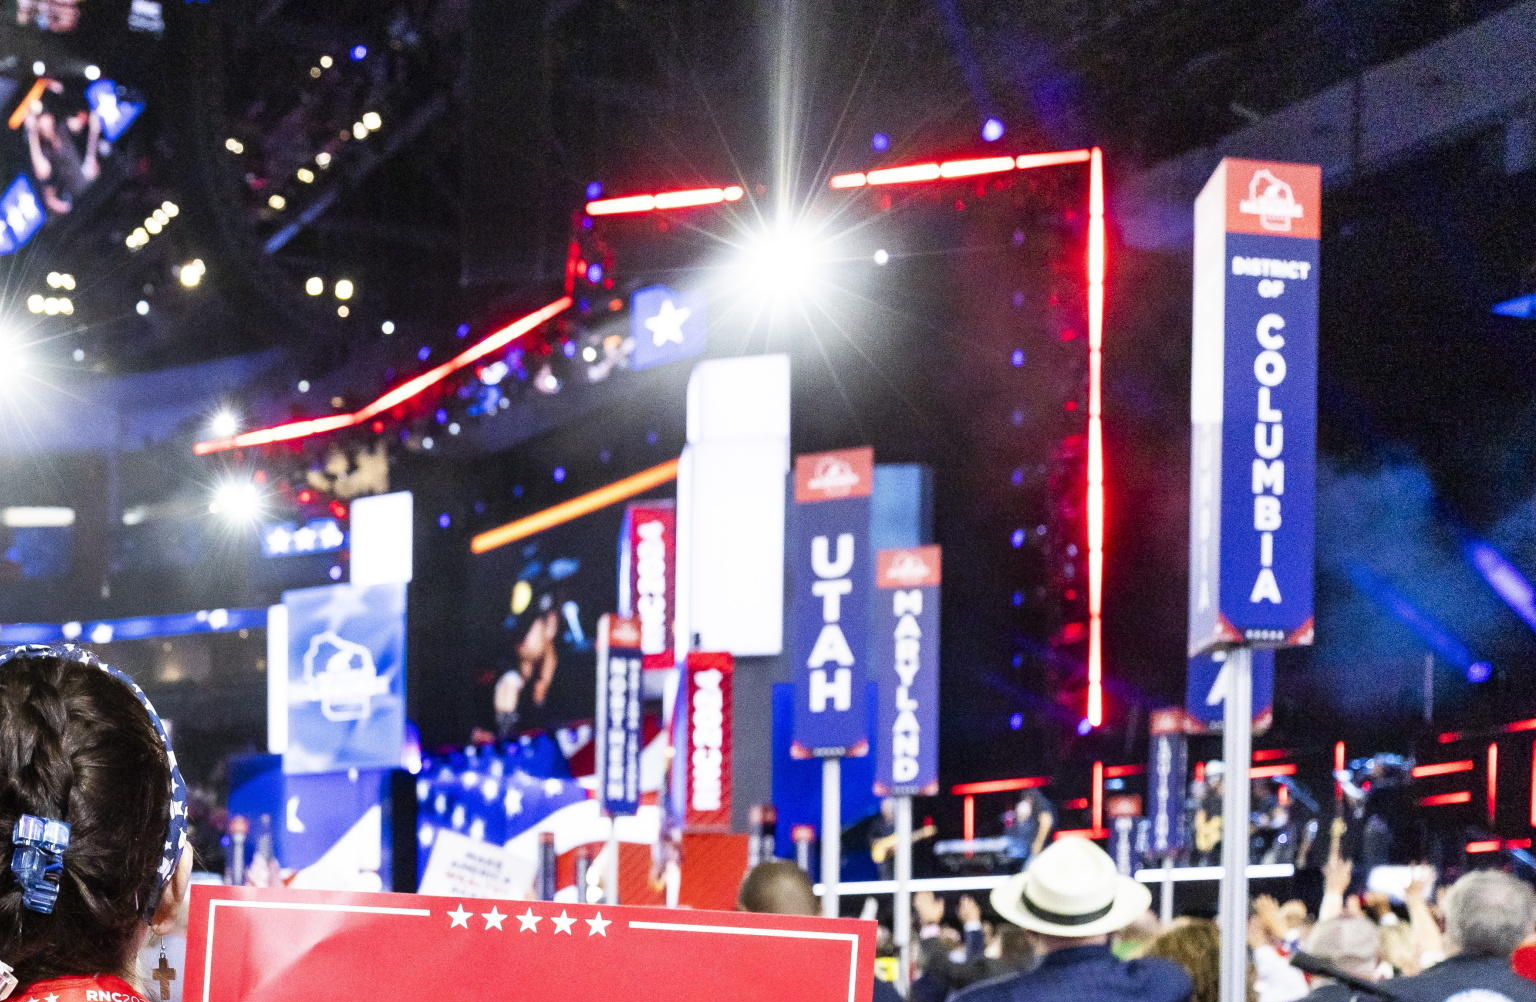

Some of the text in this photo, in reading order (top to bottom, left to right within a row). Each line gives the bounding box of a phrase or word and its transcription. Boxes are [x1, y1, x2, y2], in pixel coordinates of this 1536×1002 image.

[1231, 256, 1312, 280] DISTRICT
[1257, 279, 1285, 298] OF
[1250, 313, 1287, 604] COLUMBIA
[807, 532, 855, 713] UTAH
[891, 589, 923, 783] MARYLAND
